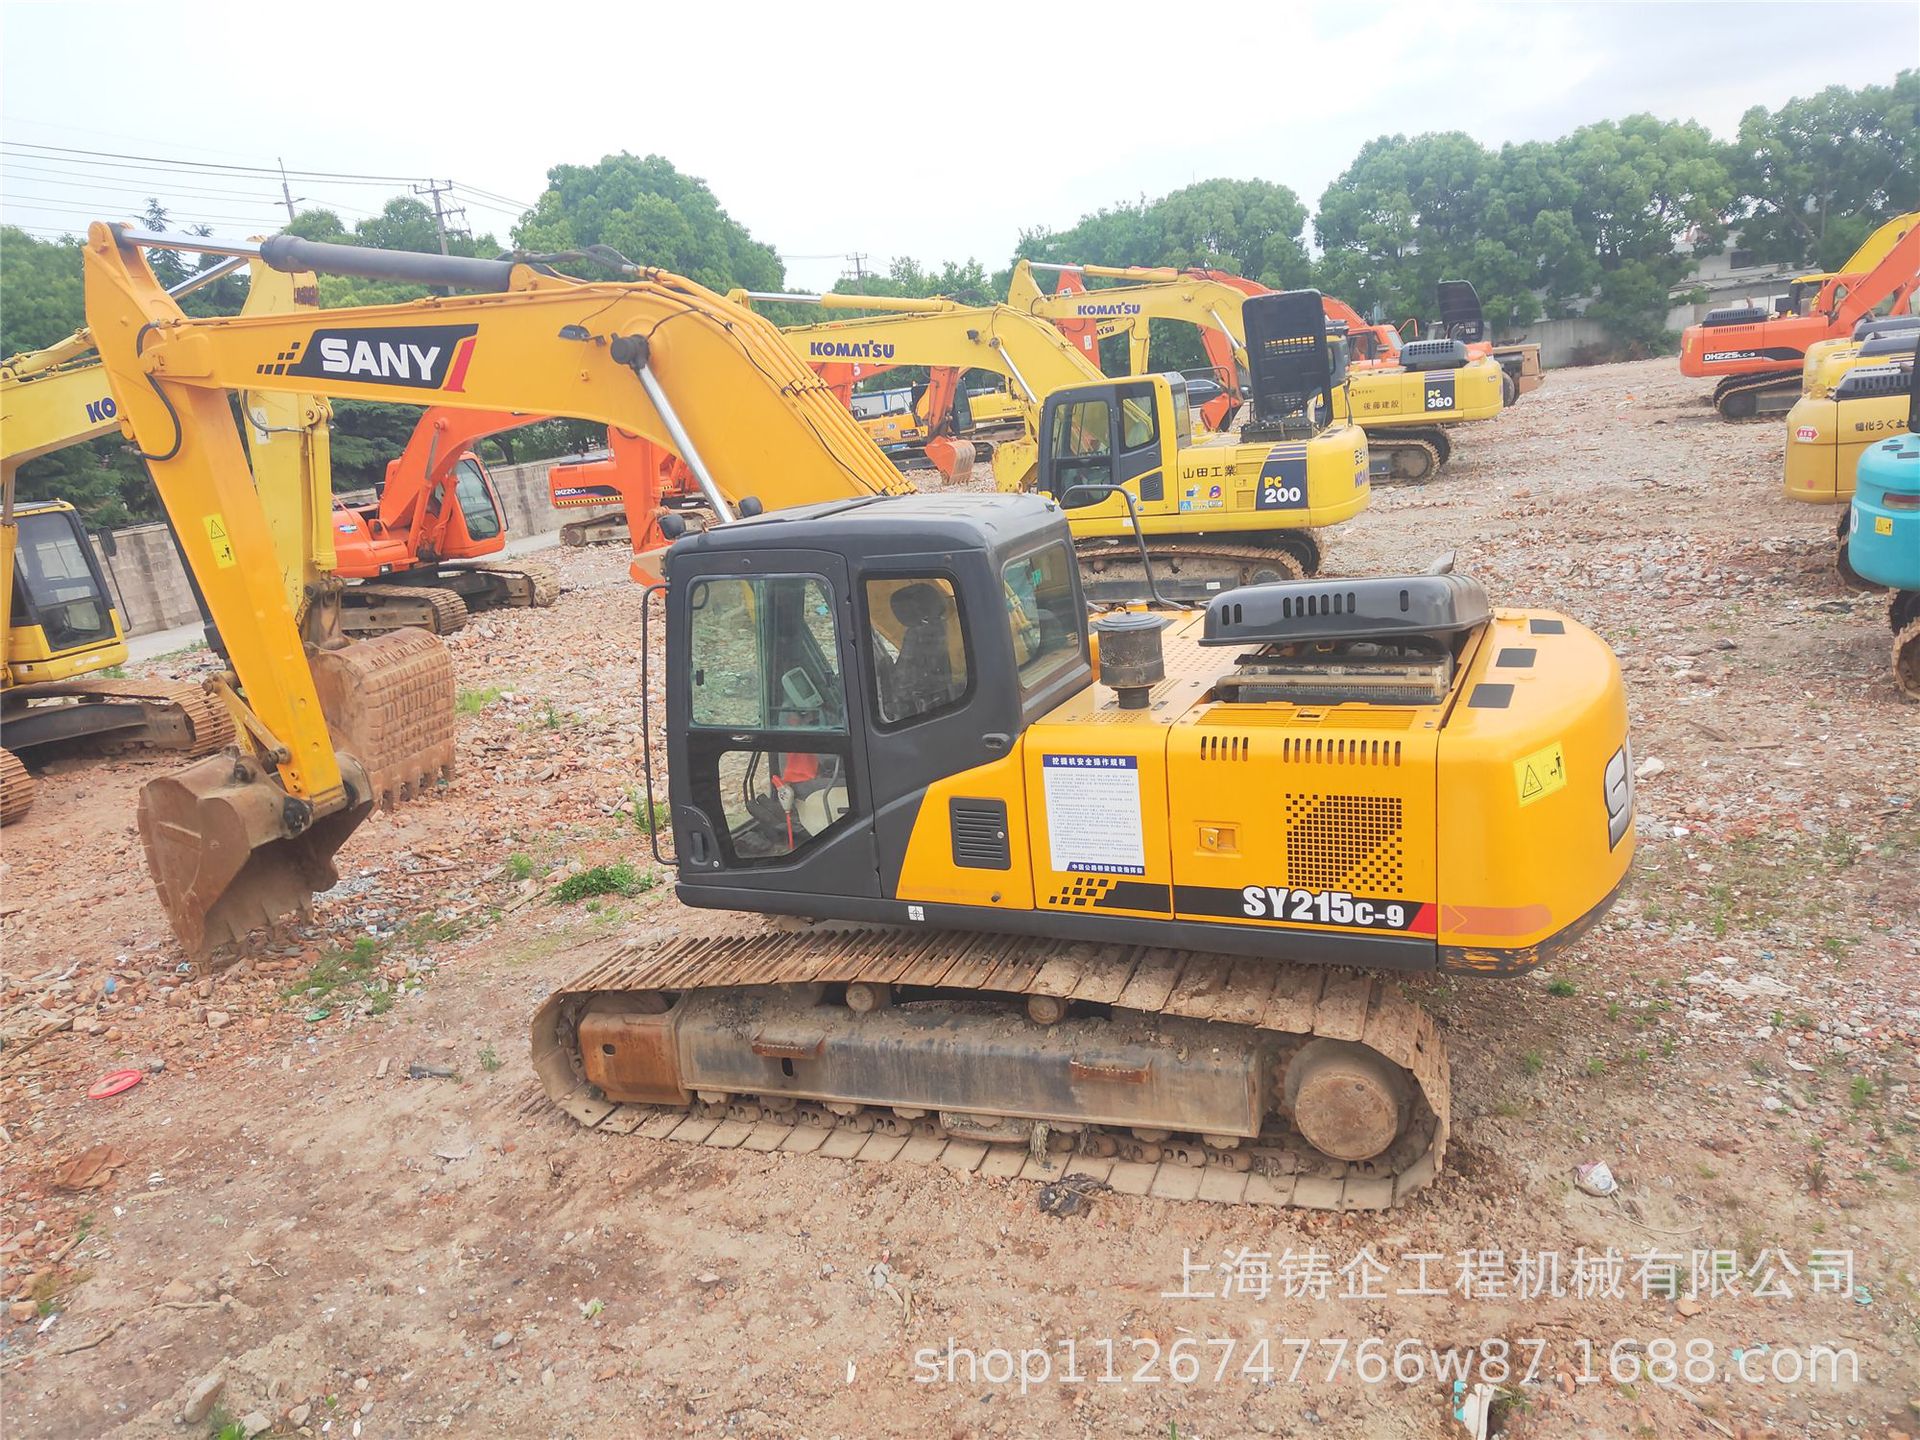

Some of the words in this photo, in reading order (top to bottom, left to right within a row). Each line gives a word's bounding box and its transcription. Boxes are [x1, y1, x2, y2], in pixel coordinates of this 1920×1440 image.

[1077, 302, 1141, 315] KOMATSU
[810, 340, 895, 358] KOMATSU
[320, 338, 441, 381] SANY
[1427, 390, 1441, 398] PC
[1427, 397, 1453, 408] 360
[1183, 464, 1237, 479] 山田工業
[1264, 476, 1282, 488] PC
[1264, 487, 1301, 503] 200
[1242, 886, 1405, 927] SY215C-9
